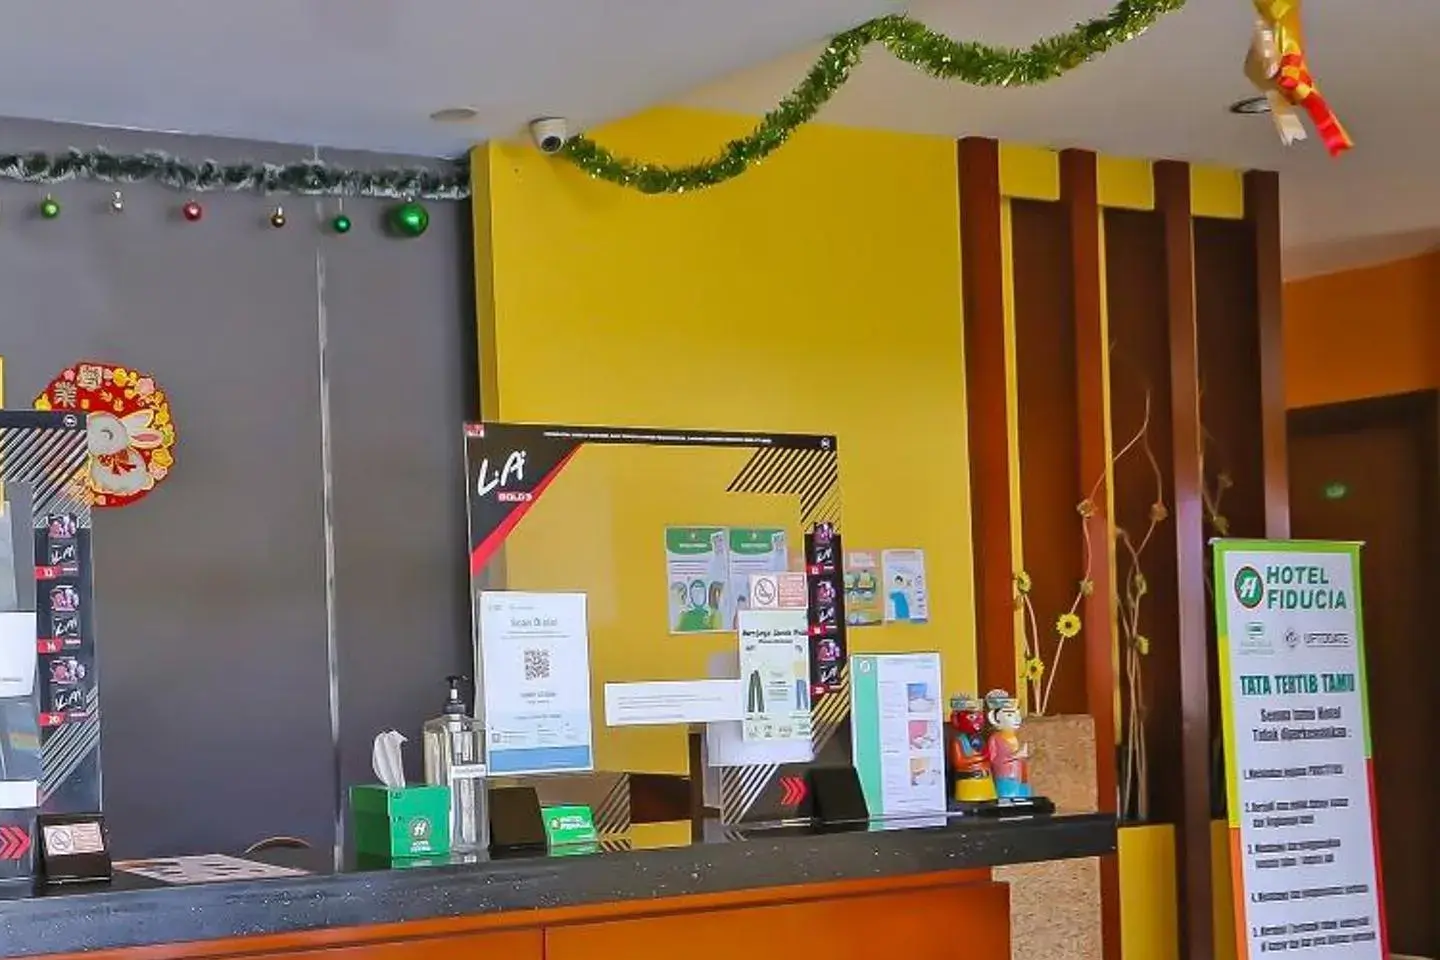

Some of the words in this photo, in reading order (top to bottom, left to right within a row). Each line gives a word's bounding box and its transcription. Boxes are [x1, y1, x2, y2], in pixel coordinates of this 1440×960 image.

[1266, 565, 1329, 585] HOTEL
[1267, 588, 1347, 610] FIDUCIA
[1240, 675, 1272, 696] TATA
[1274, 674, 1318, 694] TERTIB
